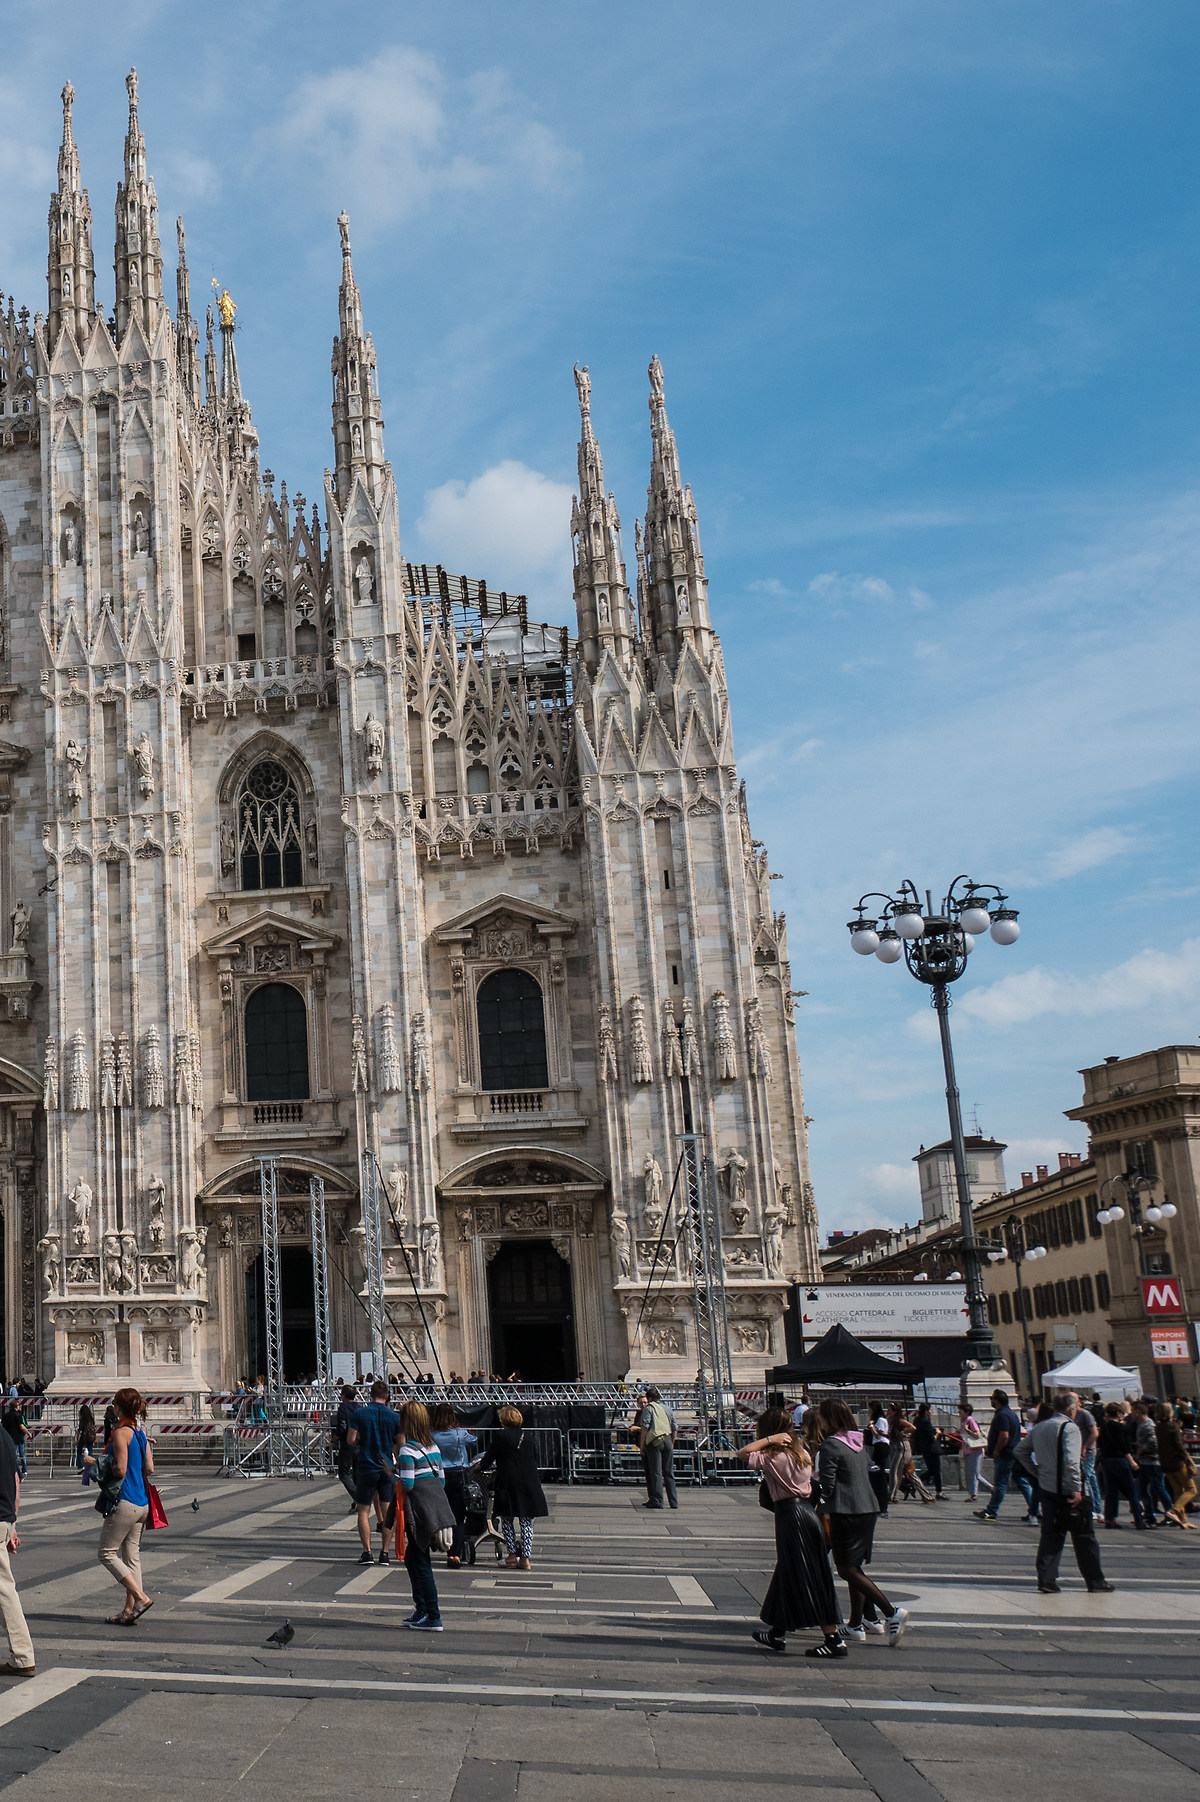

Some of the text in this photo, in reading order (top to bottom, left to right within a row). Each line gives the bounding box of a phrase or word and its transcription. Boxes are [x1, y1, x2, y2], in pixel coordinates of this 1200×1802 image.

[1146, 1284, 1180, 1307] M
[848, 1309, 895, 1317] CATTEDRALE
[912, 1308, 958, 1316] BIGLIETTERIE
